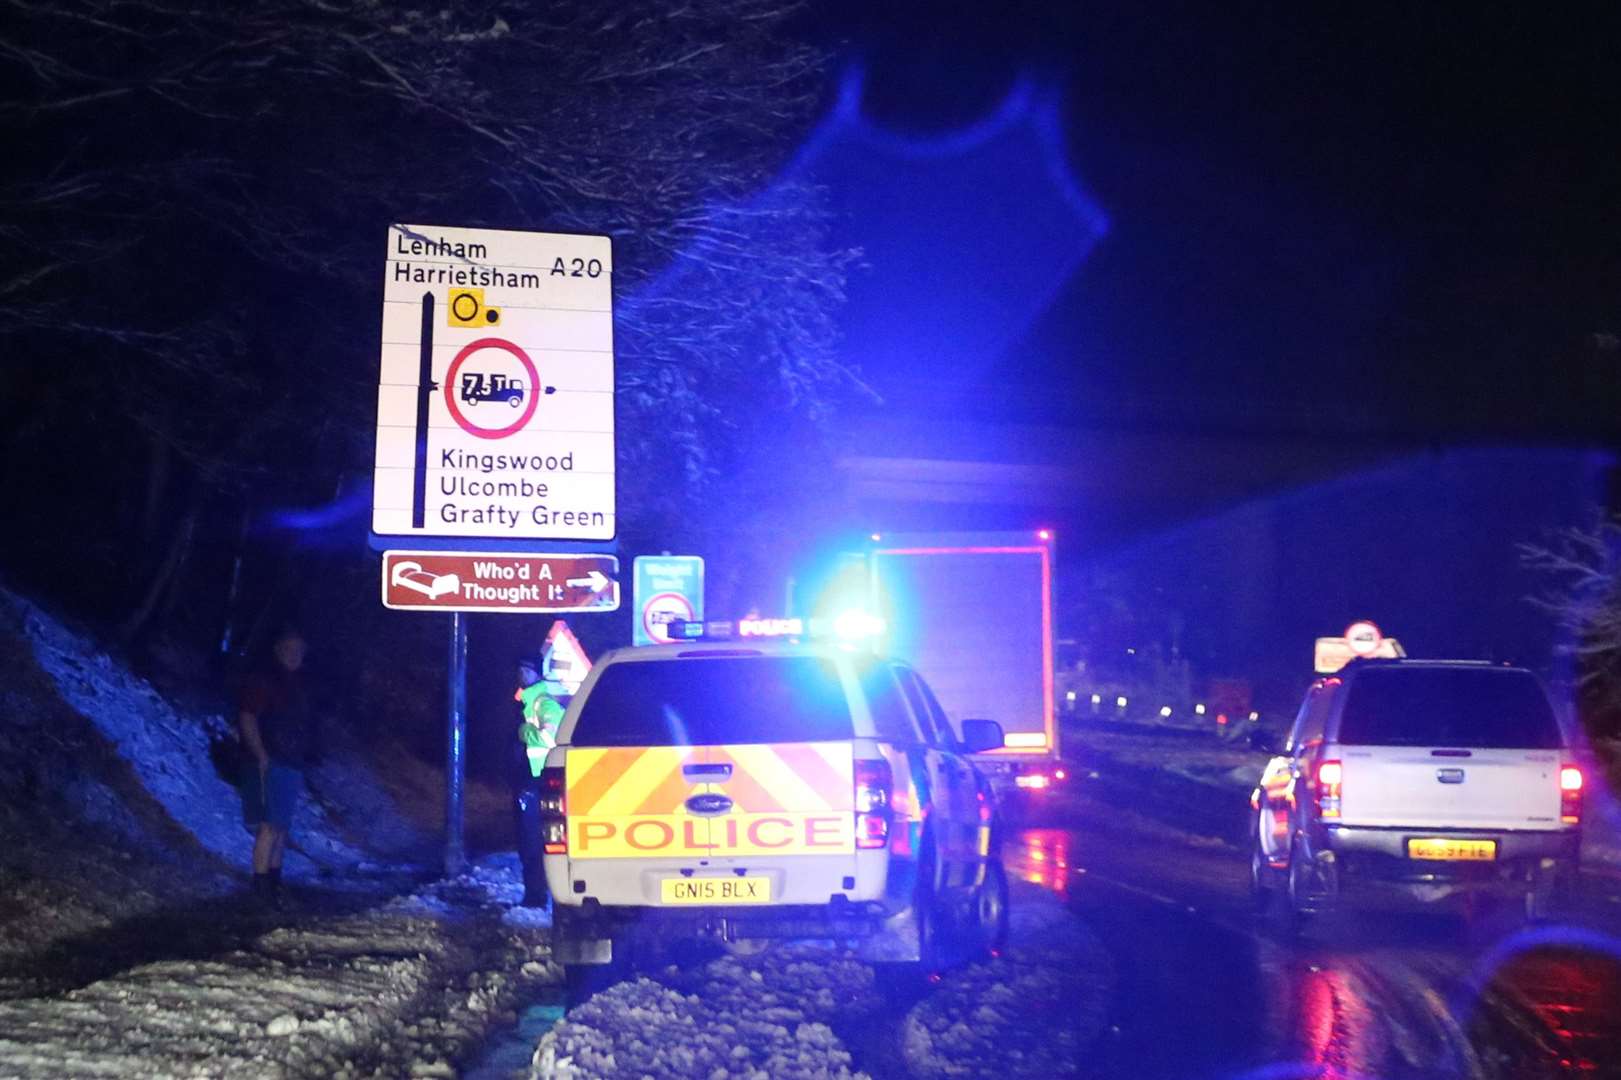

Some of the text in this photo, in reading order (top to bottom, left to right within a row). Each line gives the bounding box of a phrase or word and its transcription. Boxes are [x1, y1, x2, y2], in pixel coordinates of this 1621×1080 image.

[398, 234, 487, 258] Lenham
[395, 262, 540, 288] Harrietsham
[551, 257, 602, 278] A20
[441, 449, 573, 473] Kingswood
[441, 476, 548, 497] Ulcombe
[441, 503, 604, 528] Grafty Green
[473, 562, 552, 580] Who'd A
[463, 583, 564, 603] Thought It
[577, 817, 844, 850] POLICE
